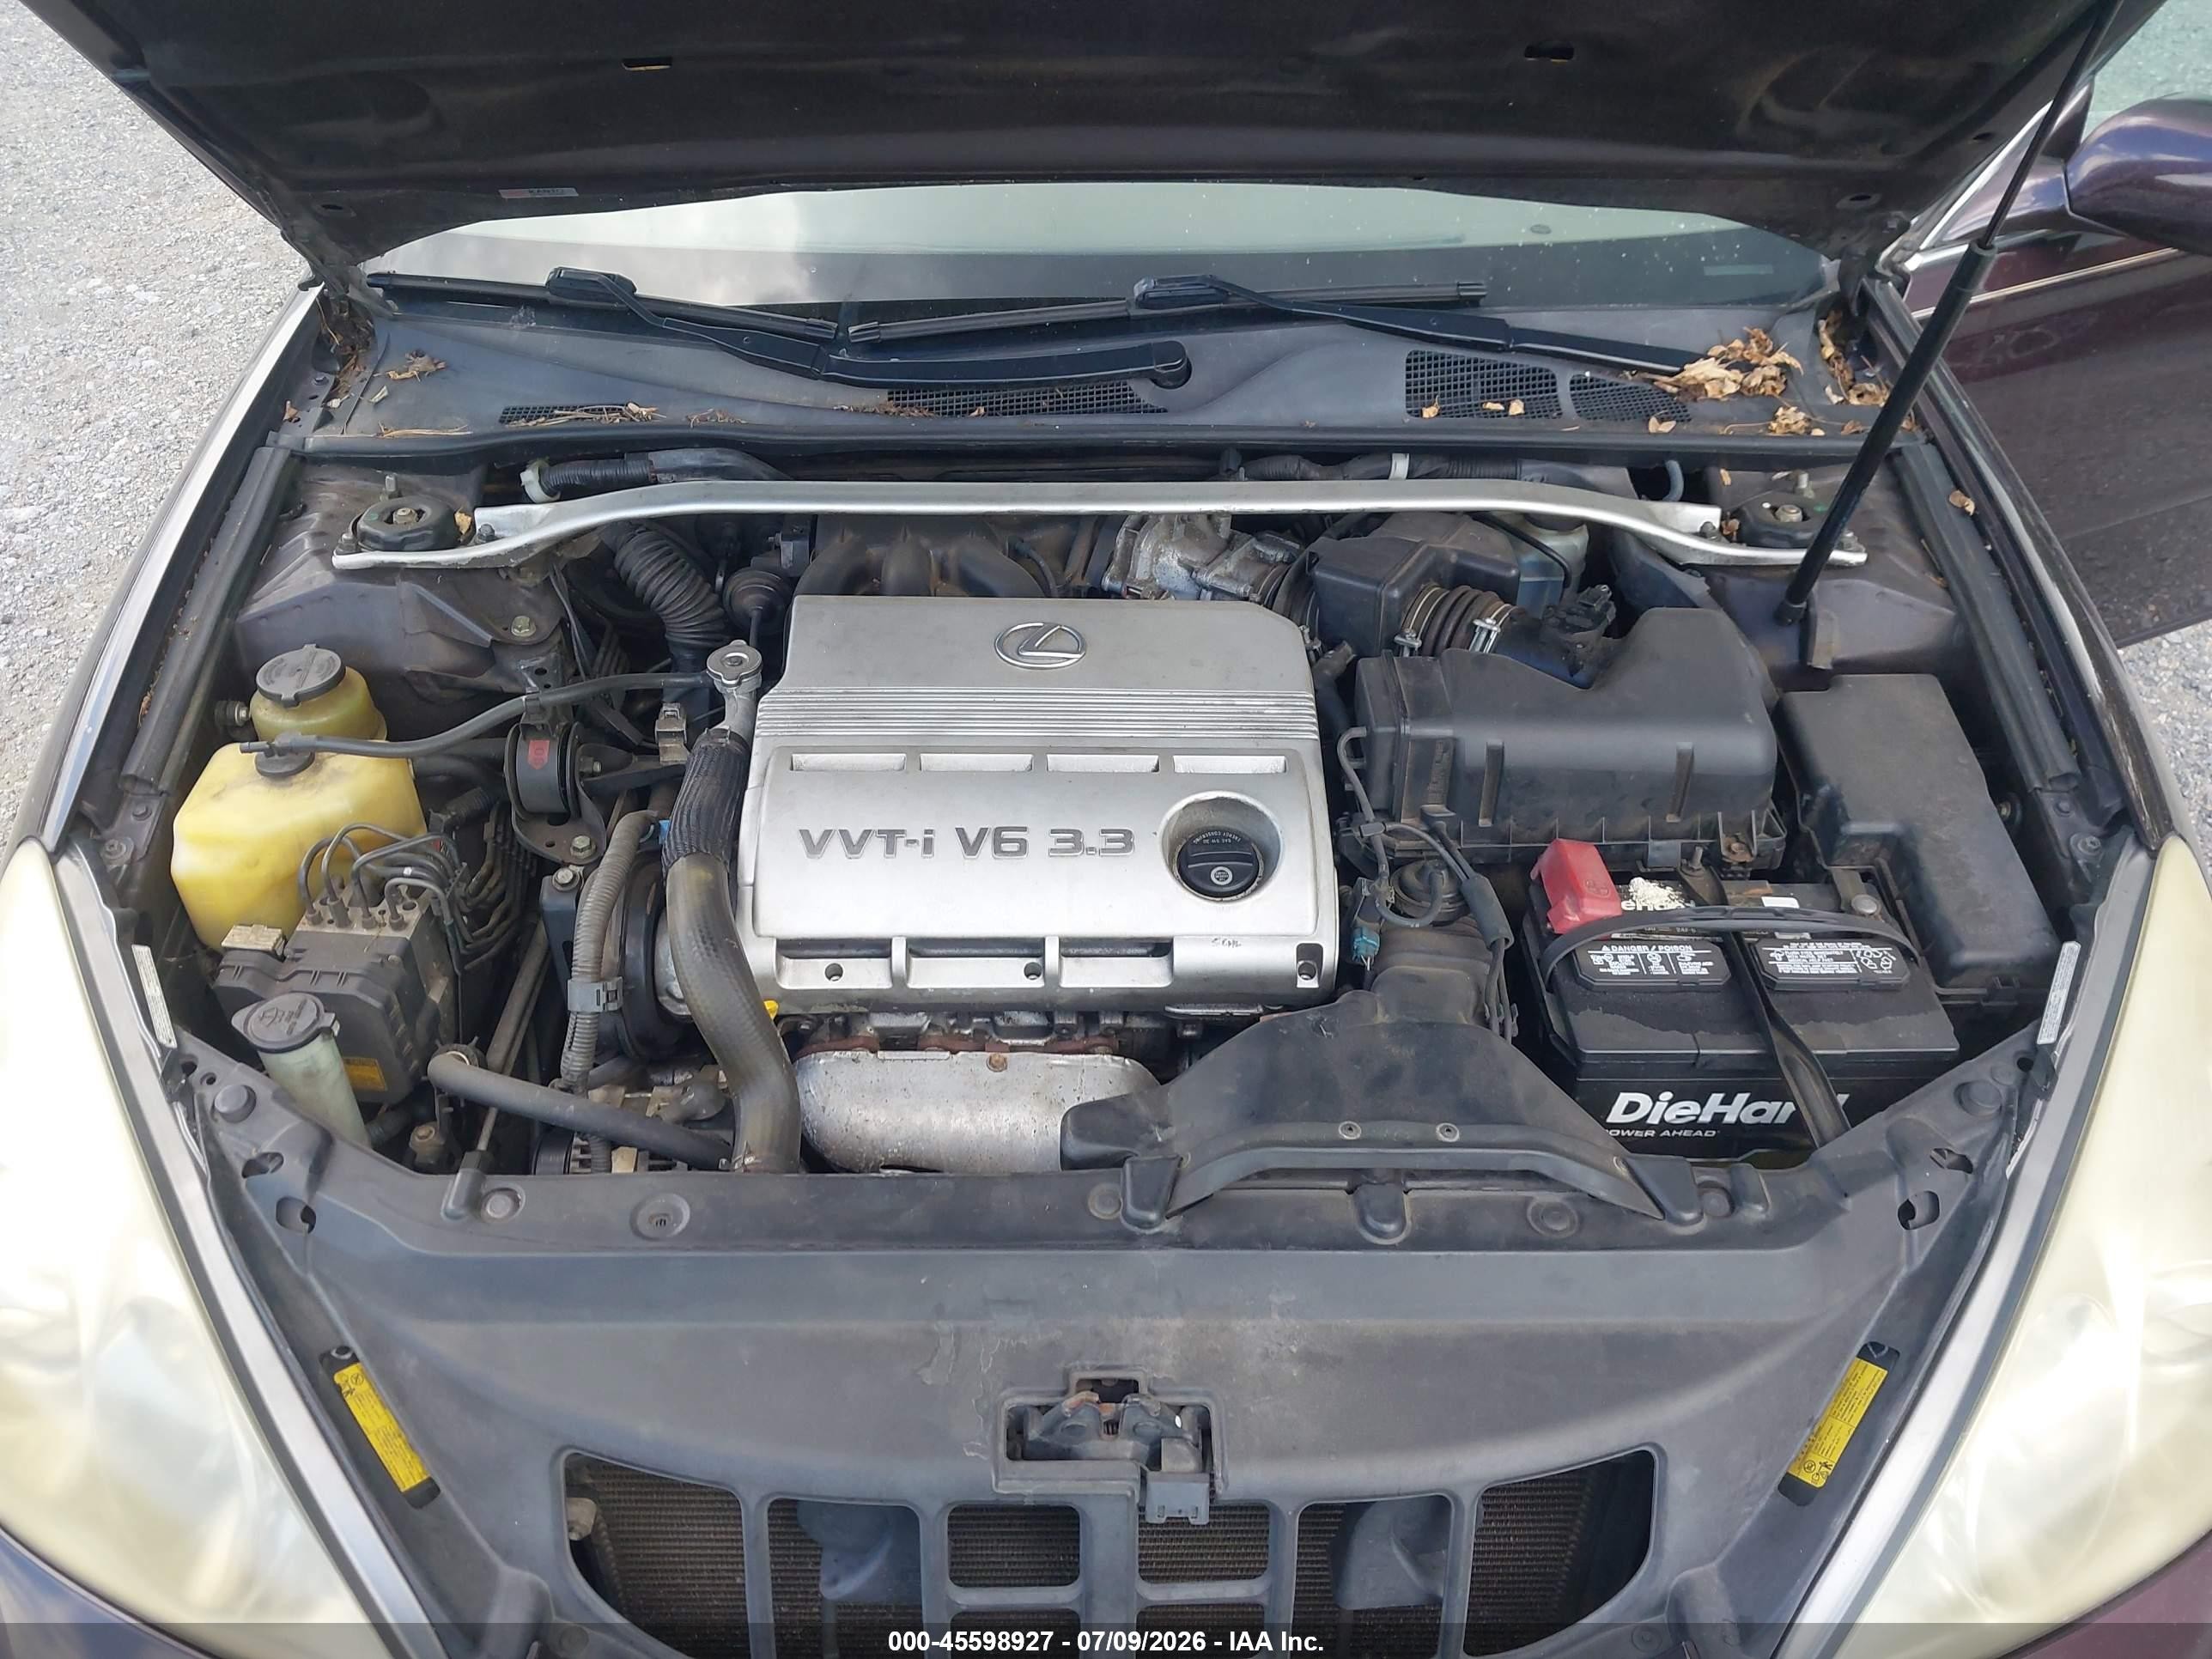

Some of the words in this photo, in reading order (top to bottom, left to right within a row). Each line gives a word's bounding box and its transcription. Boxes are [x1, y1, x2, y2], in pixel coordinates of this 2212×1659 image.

[799, 828, 936, 860] VVT-i
[954, 826, 1030, 859] V6
[1048, 828, 1135, 858] 3.3
[1606, 1091, 1850, 1125] DieHar
[1605, 1128, 1656, 1138] OWER
[1660, 1129, 1717, 1138] AHEAD
